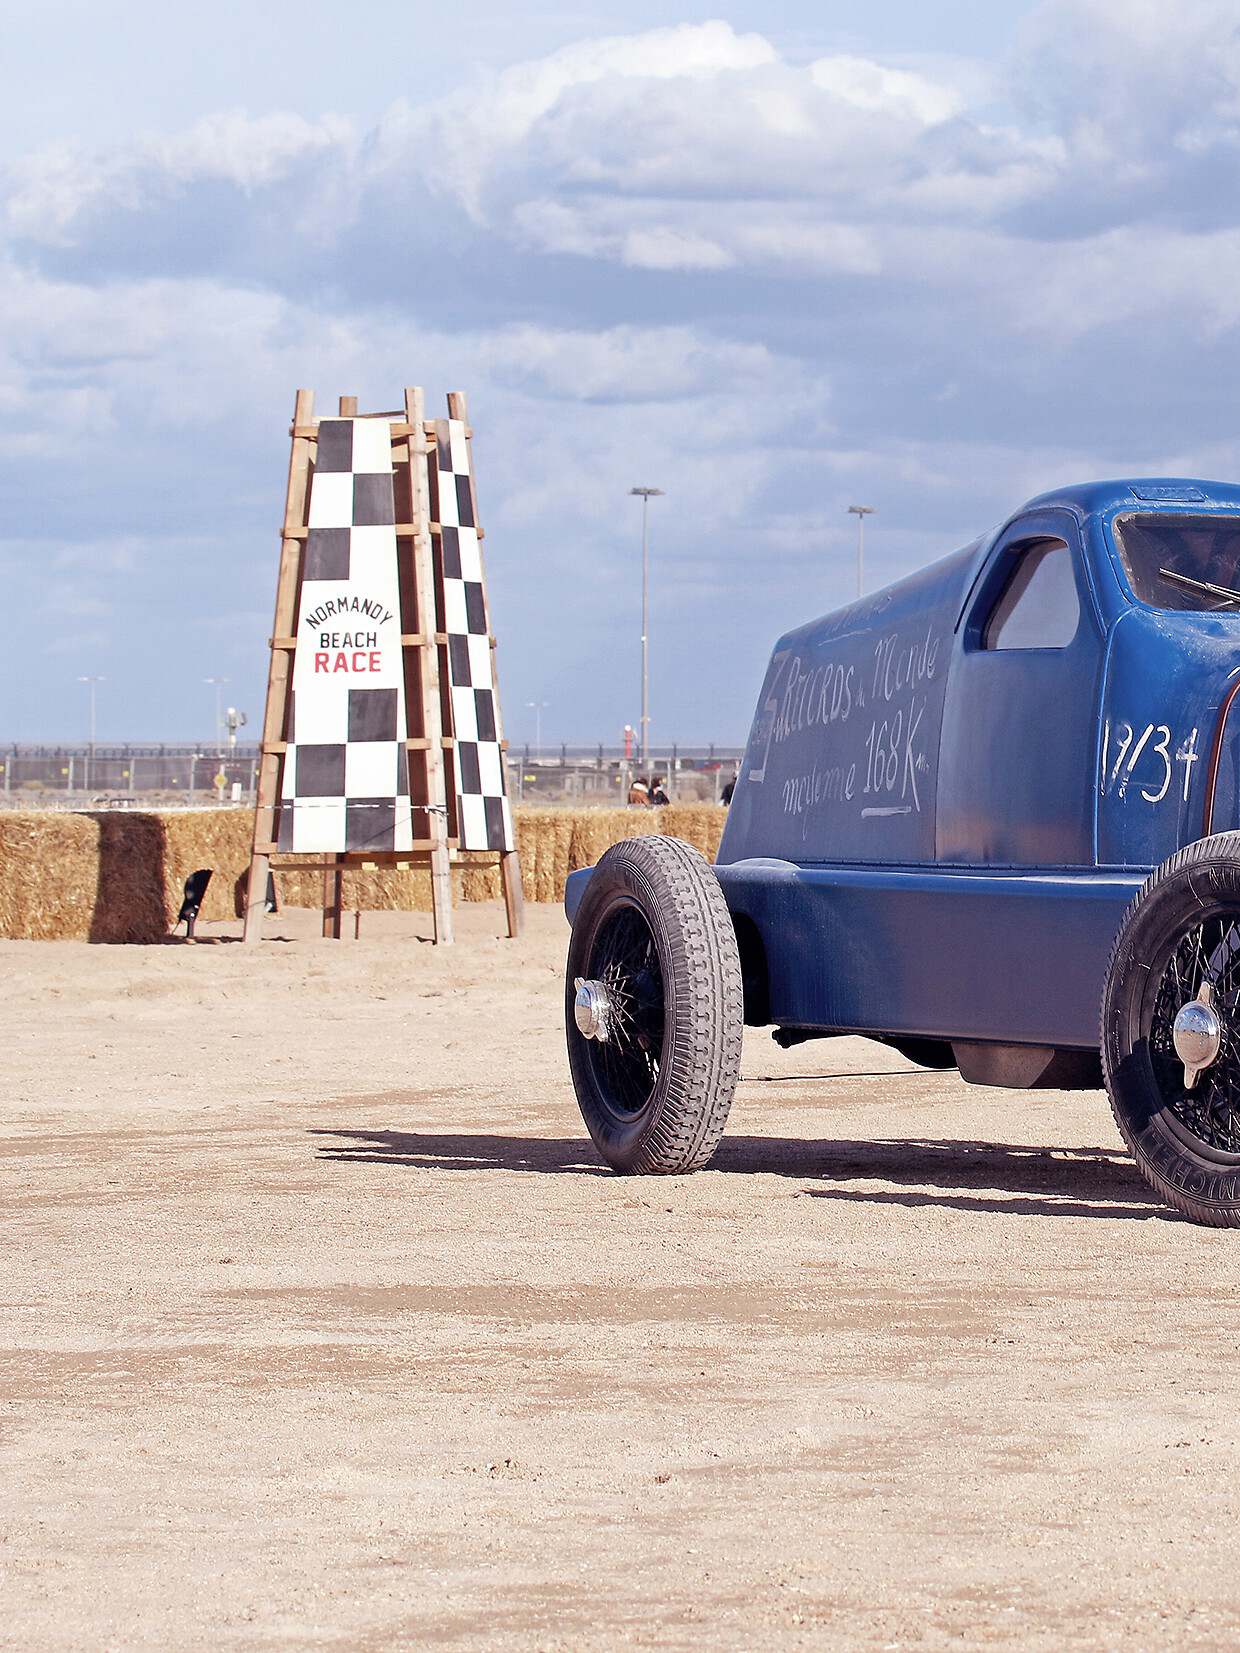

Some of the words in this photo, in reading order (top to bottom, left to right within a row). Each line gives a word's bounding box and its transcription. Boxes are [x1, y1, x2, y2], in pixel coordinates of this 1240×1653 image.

[305, 596, 393, 630] NORMANDY
[320, 632, 377, 648] BEACH
[314, 651, 382, 673] RACE
[1133, 1120, 1237, 1200] MICHELI
